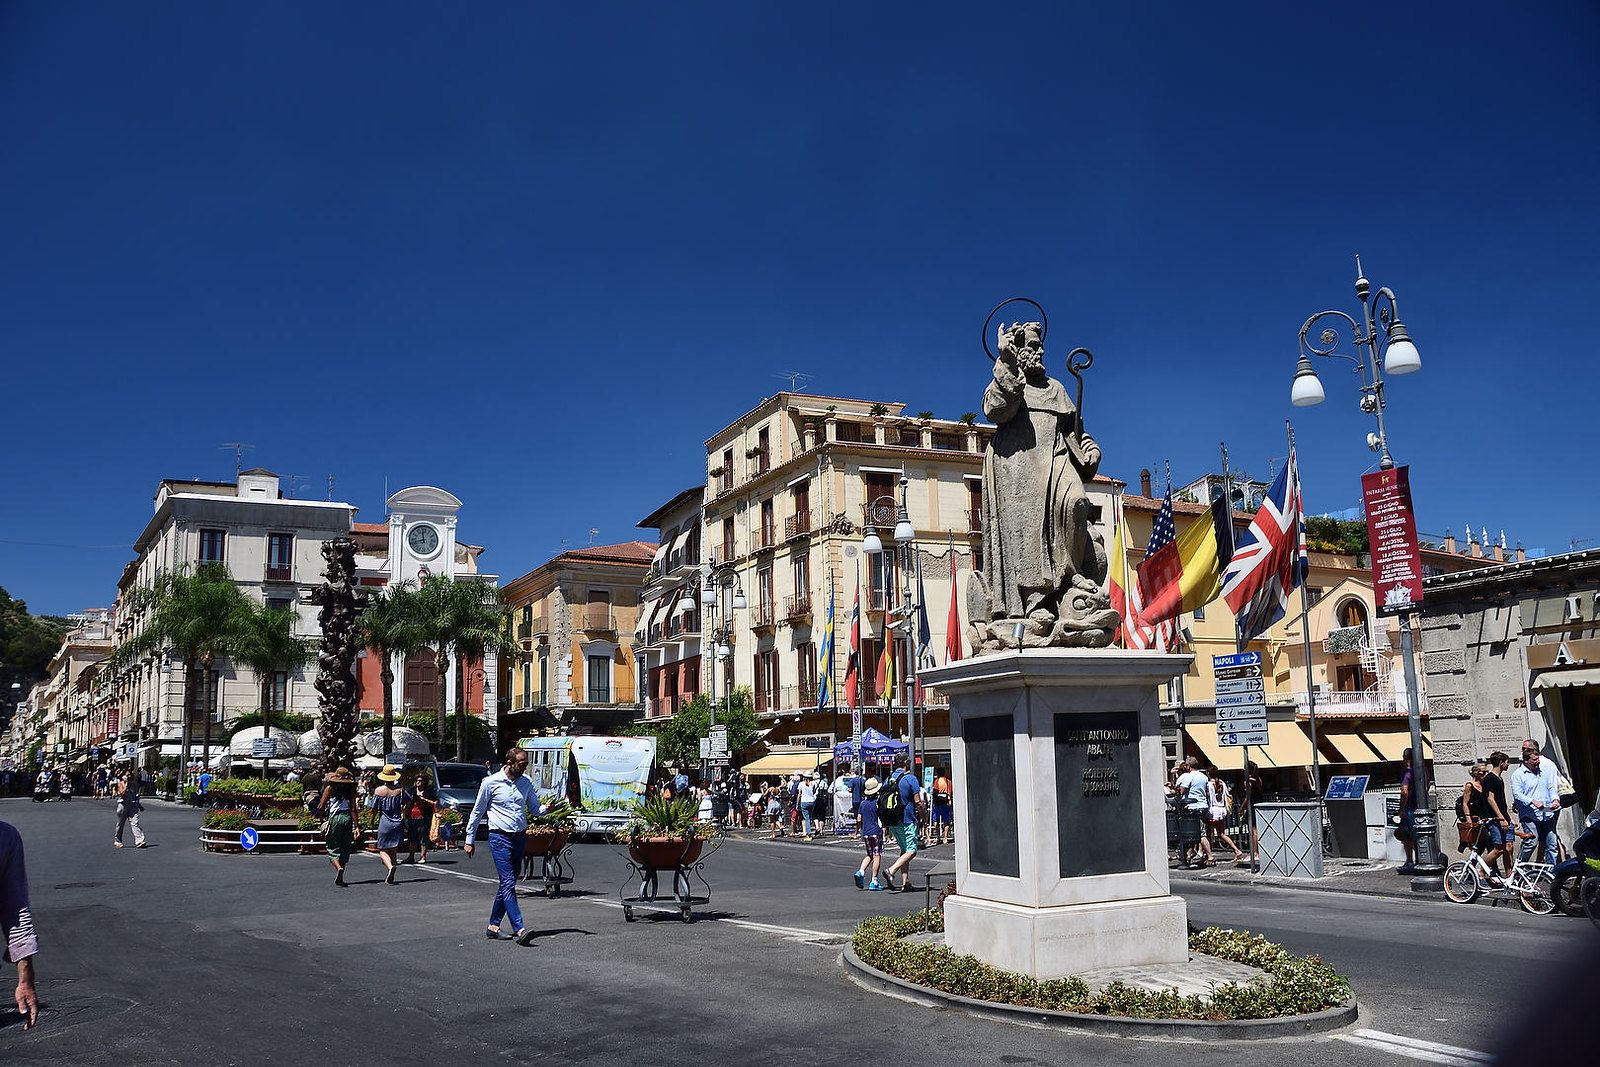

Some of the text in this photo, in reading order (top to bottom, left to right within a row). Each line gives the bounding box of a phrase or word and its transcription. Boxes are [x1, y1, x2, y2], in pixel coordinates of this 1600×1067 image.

[1215, 657, 1234, 666] NAPOLI
[1216, 697, 1243, 705] BANCOMAT
[1087, 743, 1114, 755] ABATE
